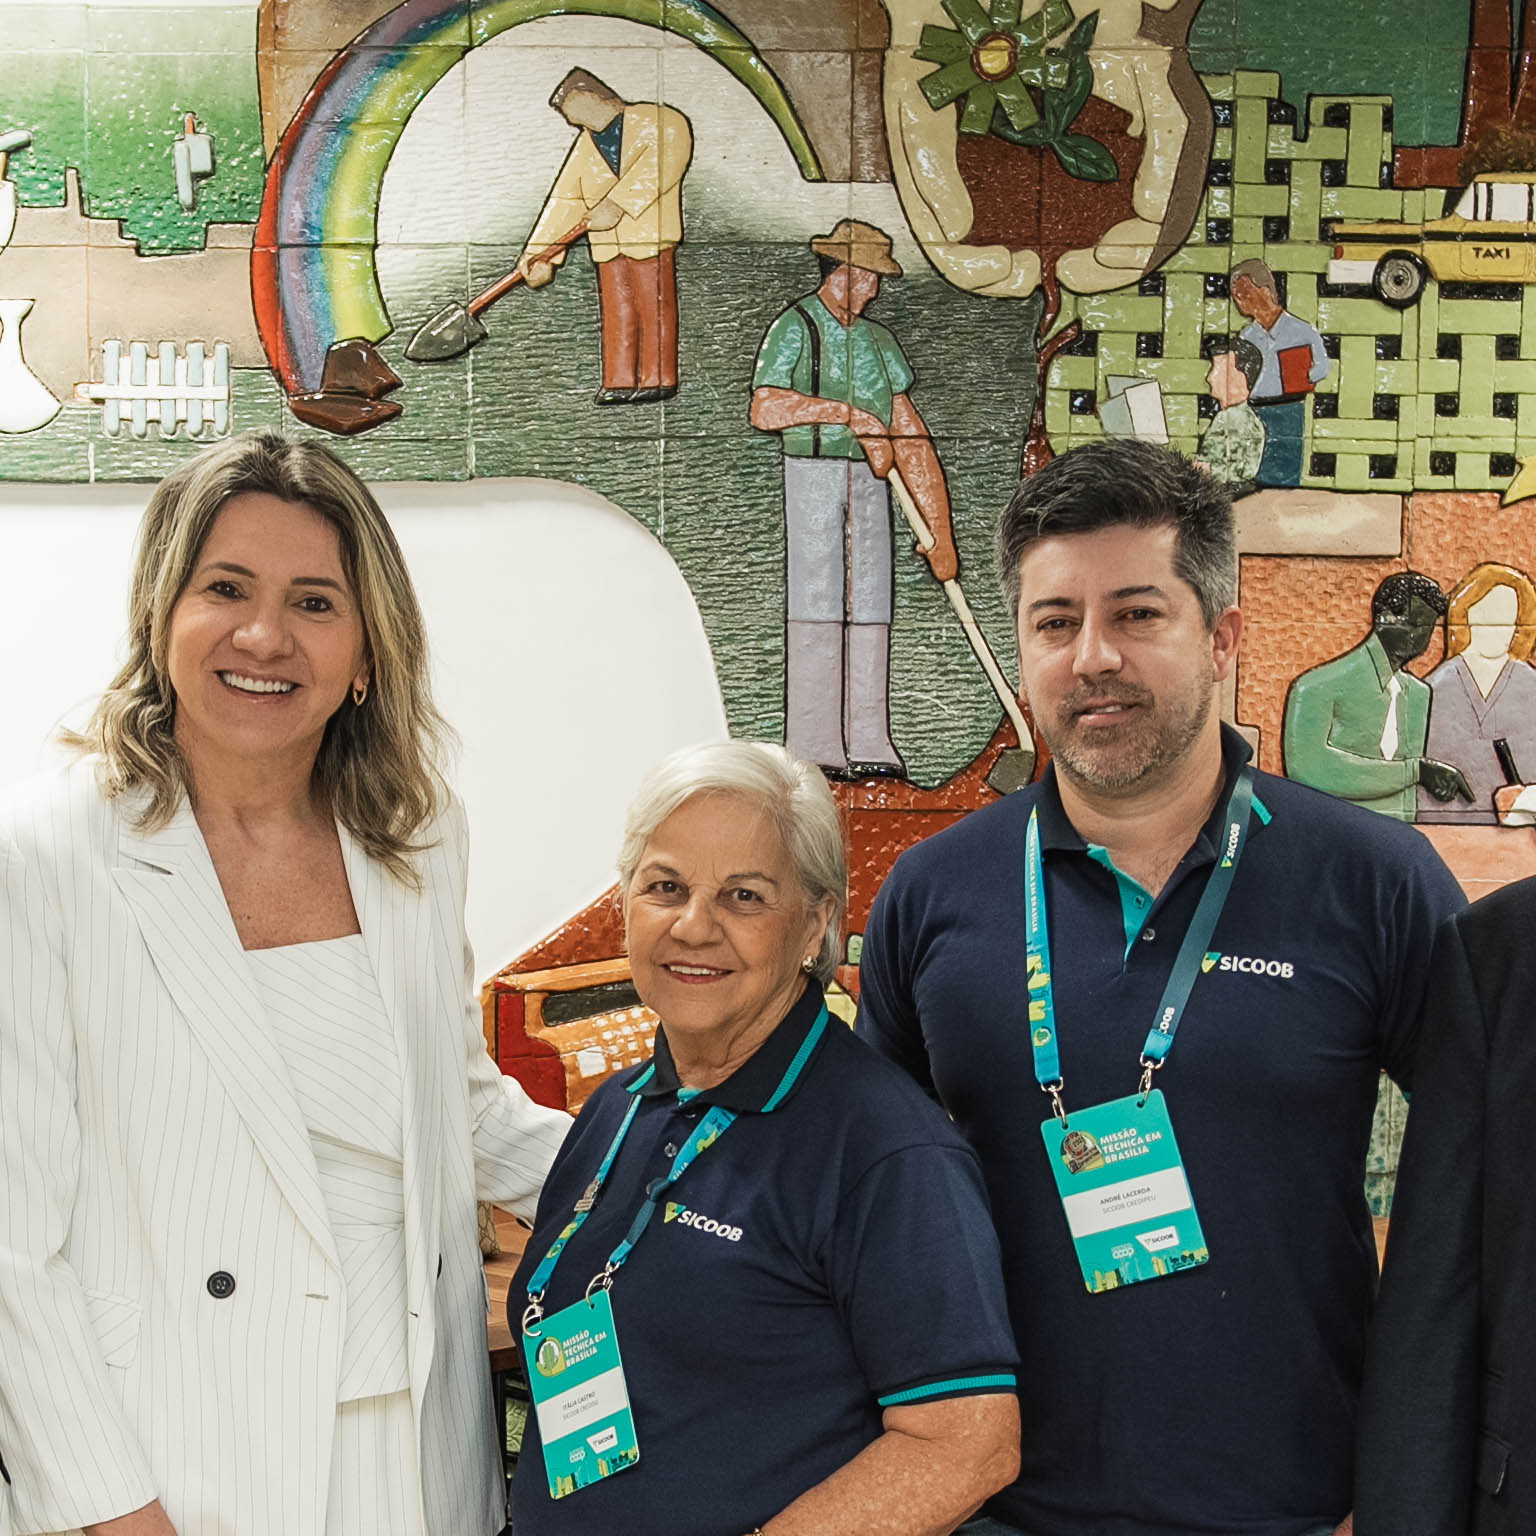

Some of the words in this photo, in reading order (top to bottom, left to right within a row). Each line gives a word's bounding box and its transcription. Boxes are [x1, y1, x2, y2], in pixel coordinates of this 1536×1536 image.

[1473, 246, 1511, 260] TAXI
[1226, 822, 1241, 859] SICOOB
[1219, 955, 1295, 979] SICOOB
[1099, 1127, 1138, 1146] MISSÃO
[1101, 1136, 1145, 1155] TÉCNICA
[1144, 1131, 1162, 1143] EM
[1104, 1145, 1150, 1164] BRASÍLIA
[1100, 1194, 1121, 1205] ANDRÉ
[1122, 1187, 1151, 1199] LACERDA
[1102, 1203, 1125, 1214] SICOOB
[677, 1210, 744, 1242] SICOOB
[1151, 1233, 1174, 1243] SICOOB
[562, 1329, 590, 1348] MISSÃO
[595, 1331, 607, 1343] EM
[566, 1347, 598, 1367] BRASÍLIA
